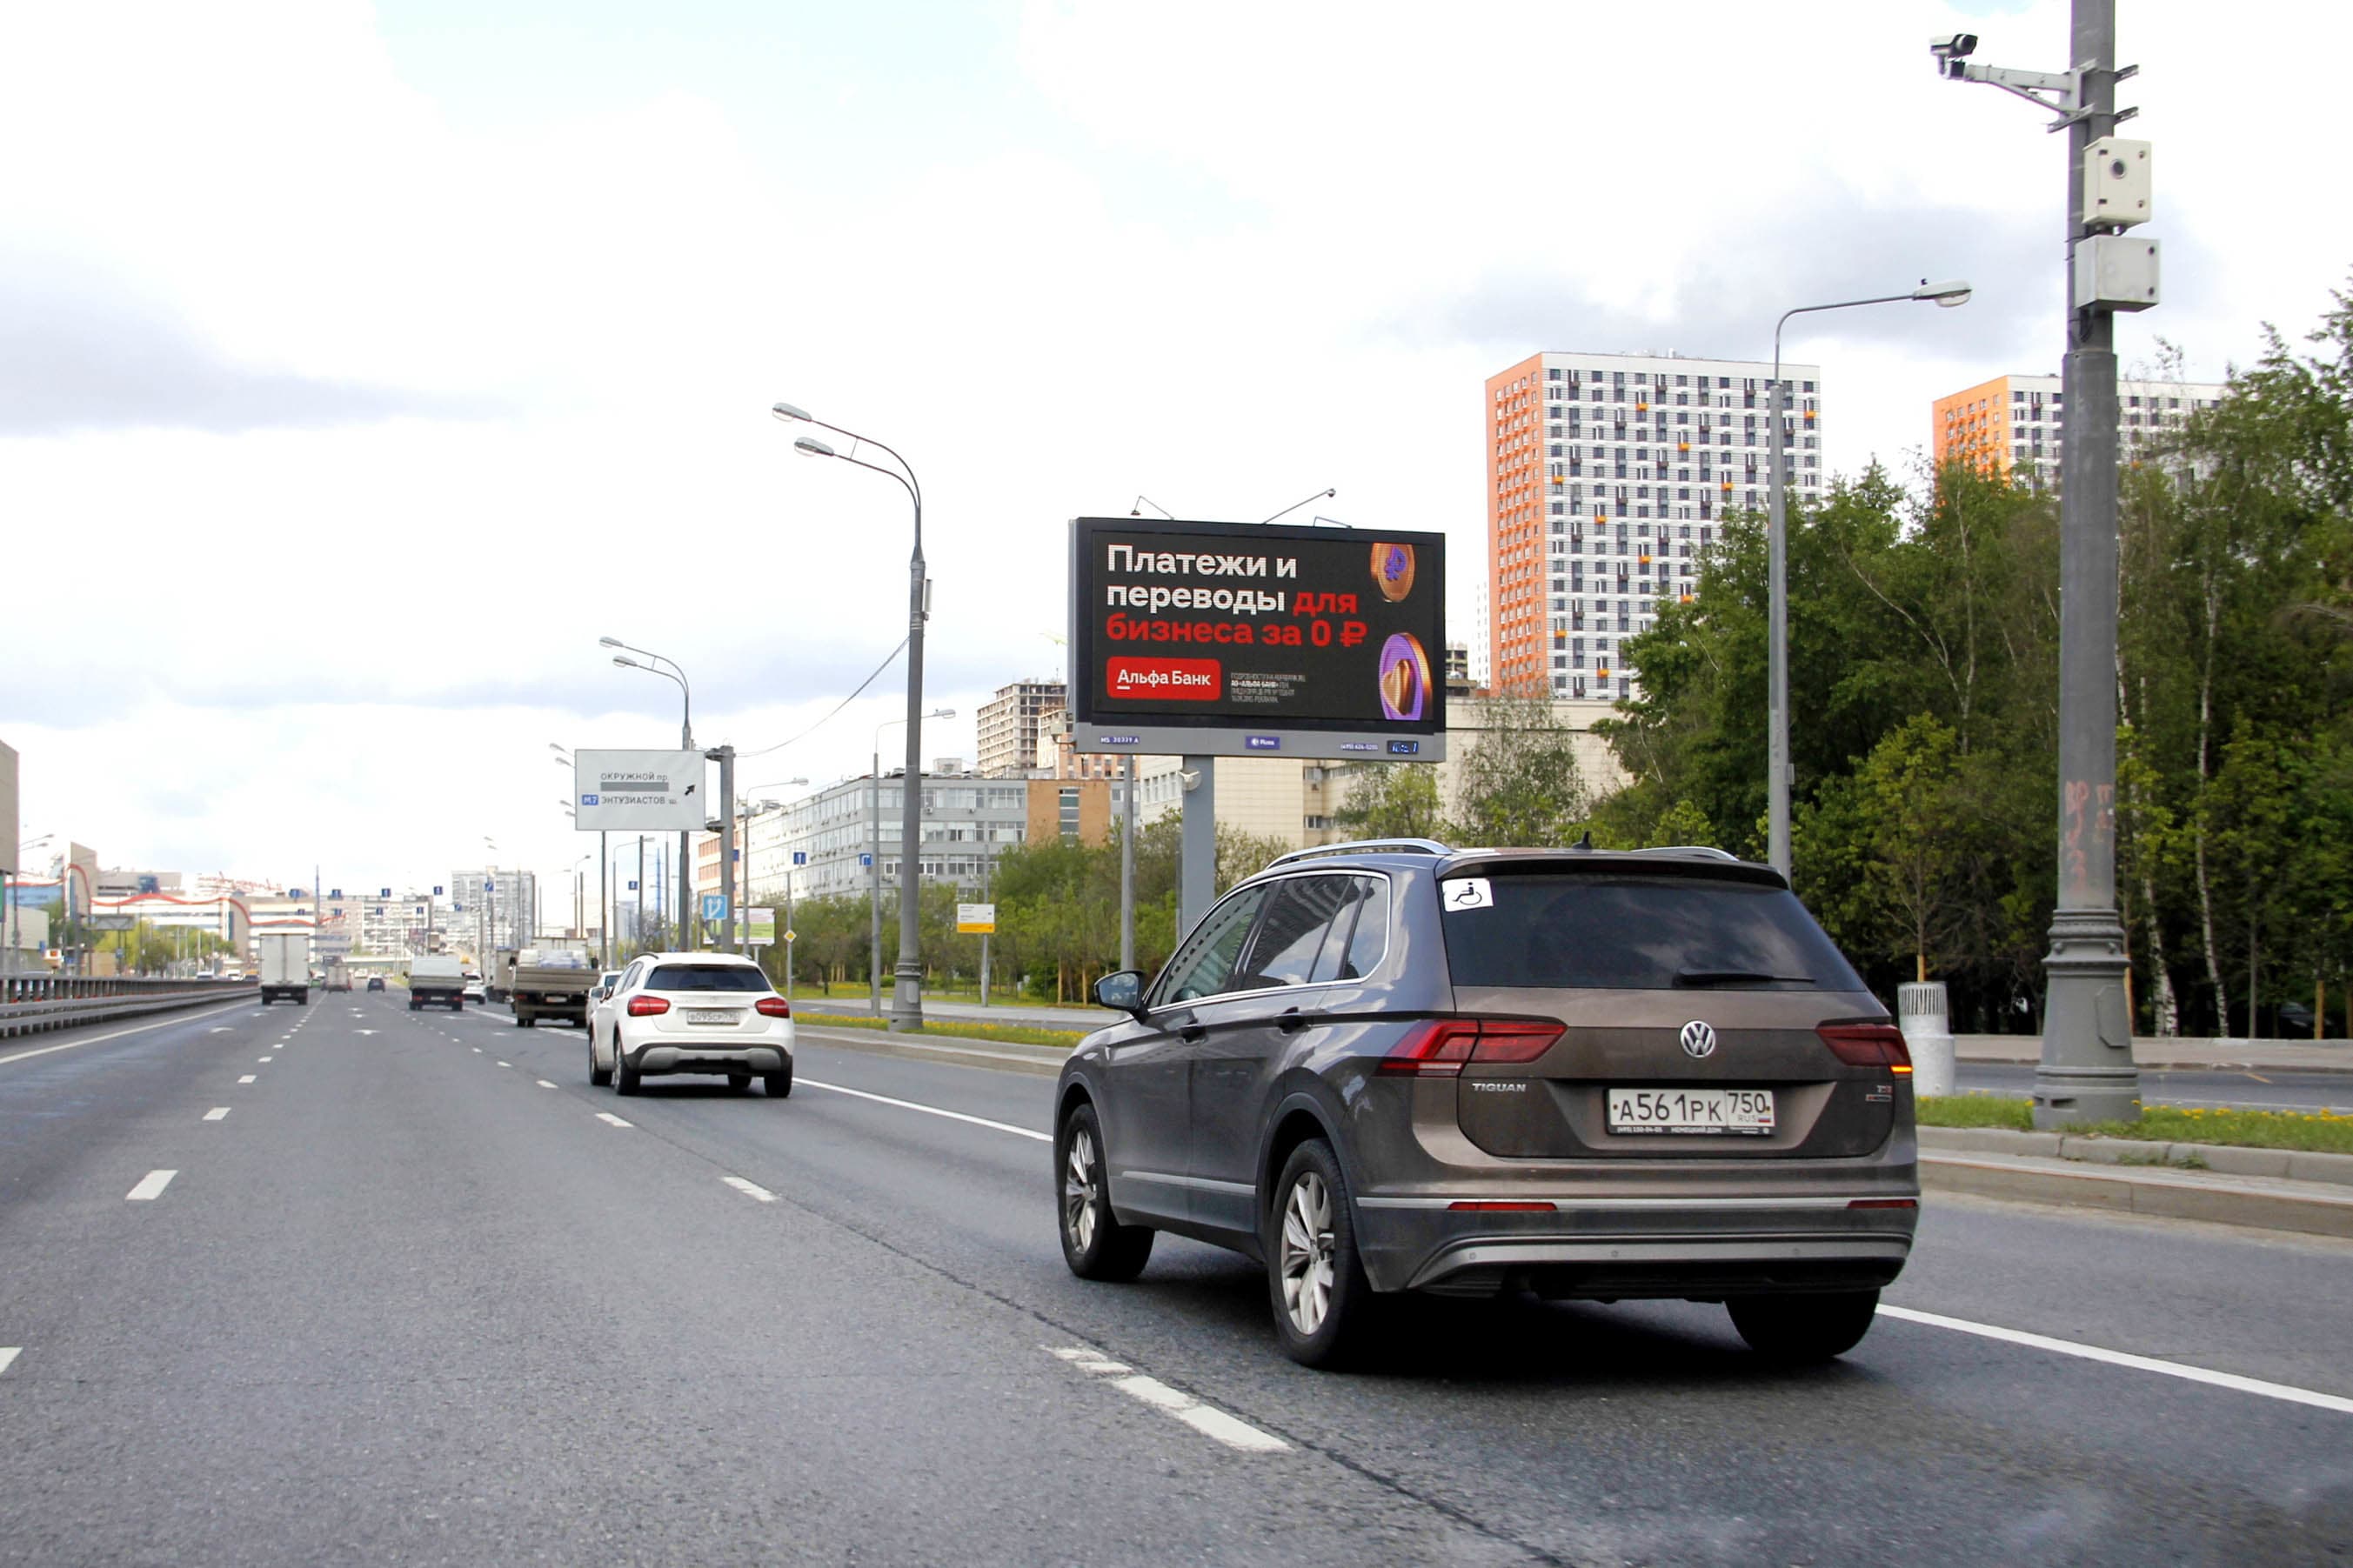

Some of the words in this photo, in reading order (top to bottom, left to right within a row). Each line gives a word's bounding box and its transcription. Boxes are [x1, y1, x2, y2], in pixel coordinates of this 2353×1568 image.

[1107, 543, 1267, 577] Платежи
[1276, 557, 1297, 578] и
[1106, 584, 1285, 615] переводы
[1293, 591, 1358, 617] для
[1106, 612, 1253, 644] бизнеса
[1262, 624, 1302, 646] за
[1311, 619, 1332, 647] 0
[1117, 669, 1169, 689] Альфа
[1172, 670, 1211, 685] Банк
[600, 772, 655, 781] ОКРУЖНОЙ
[1472, 1083, 1527, 1092] TIGUAN
[1728, 1092, 1767, 1114] 750
